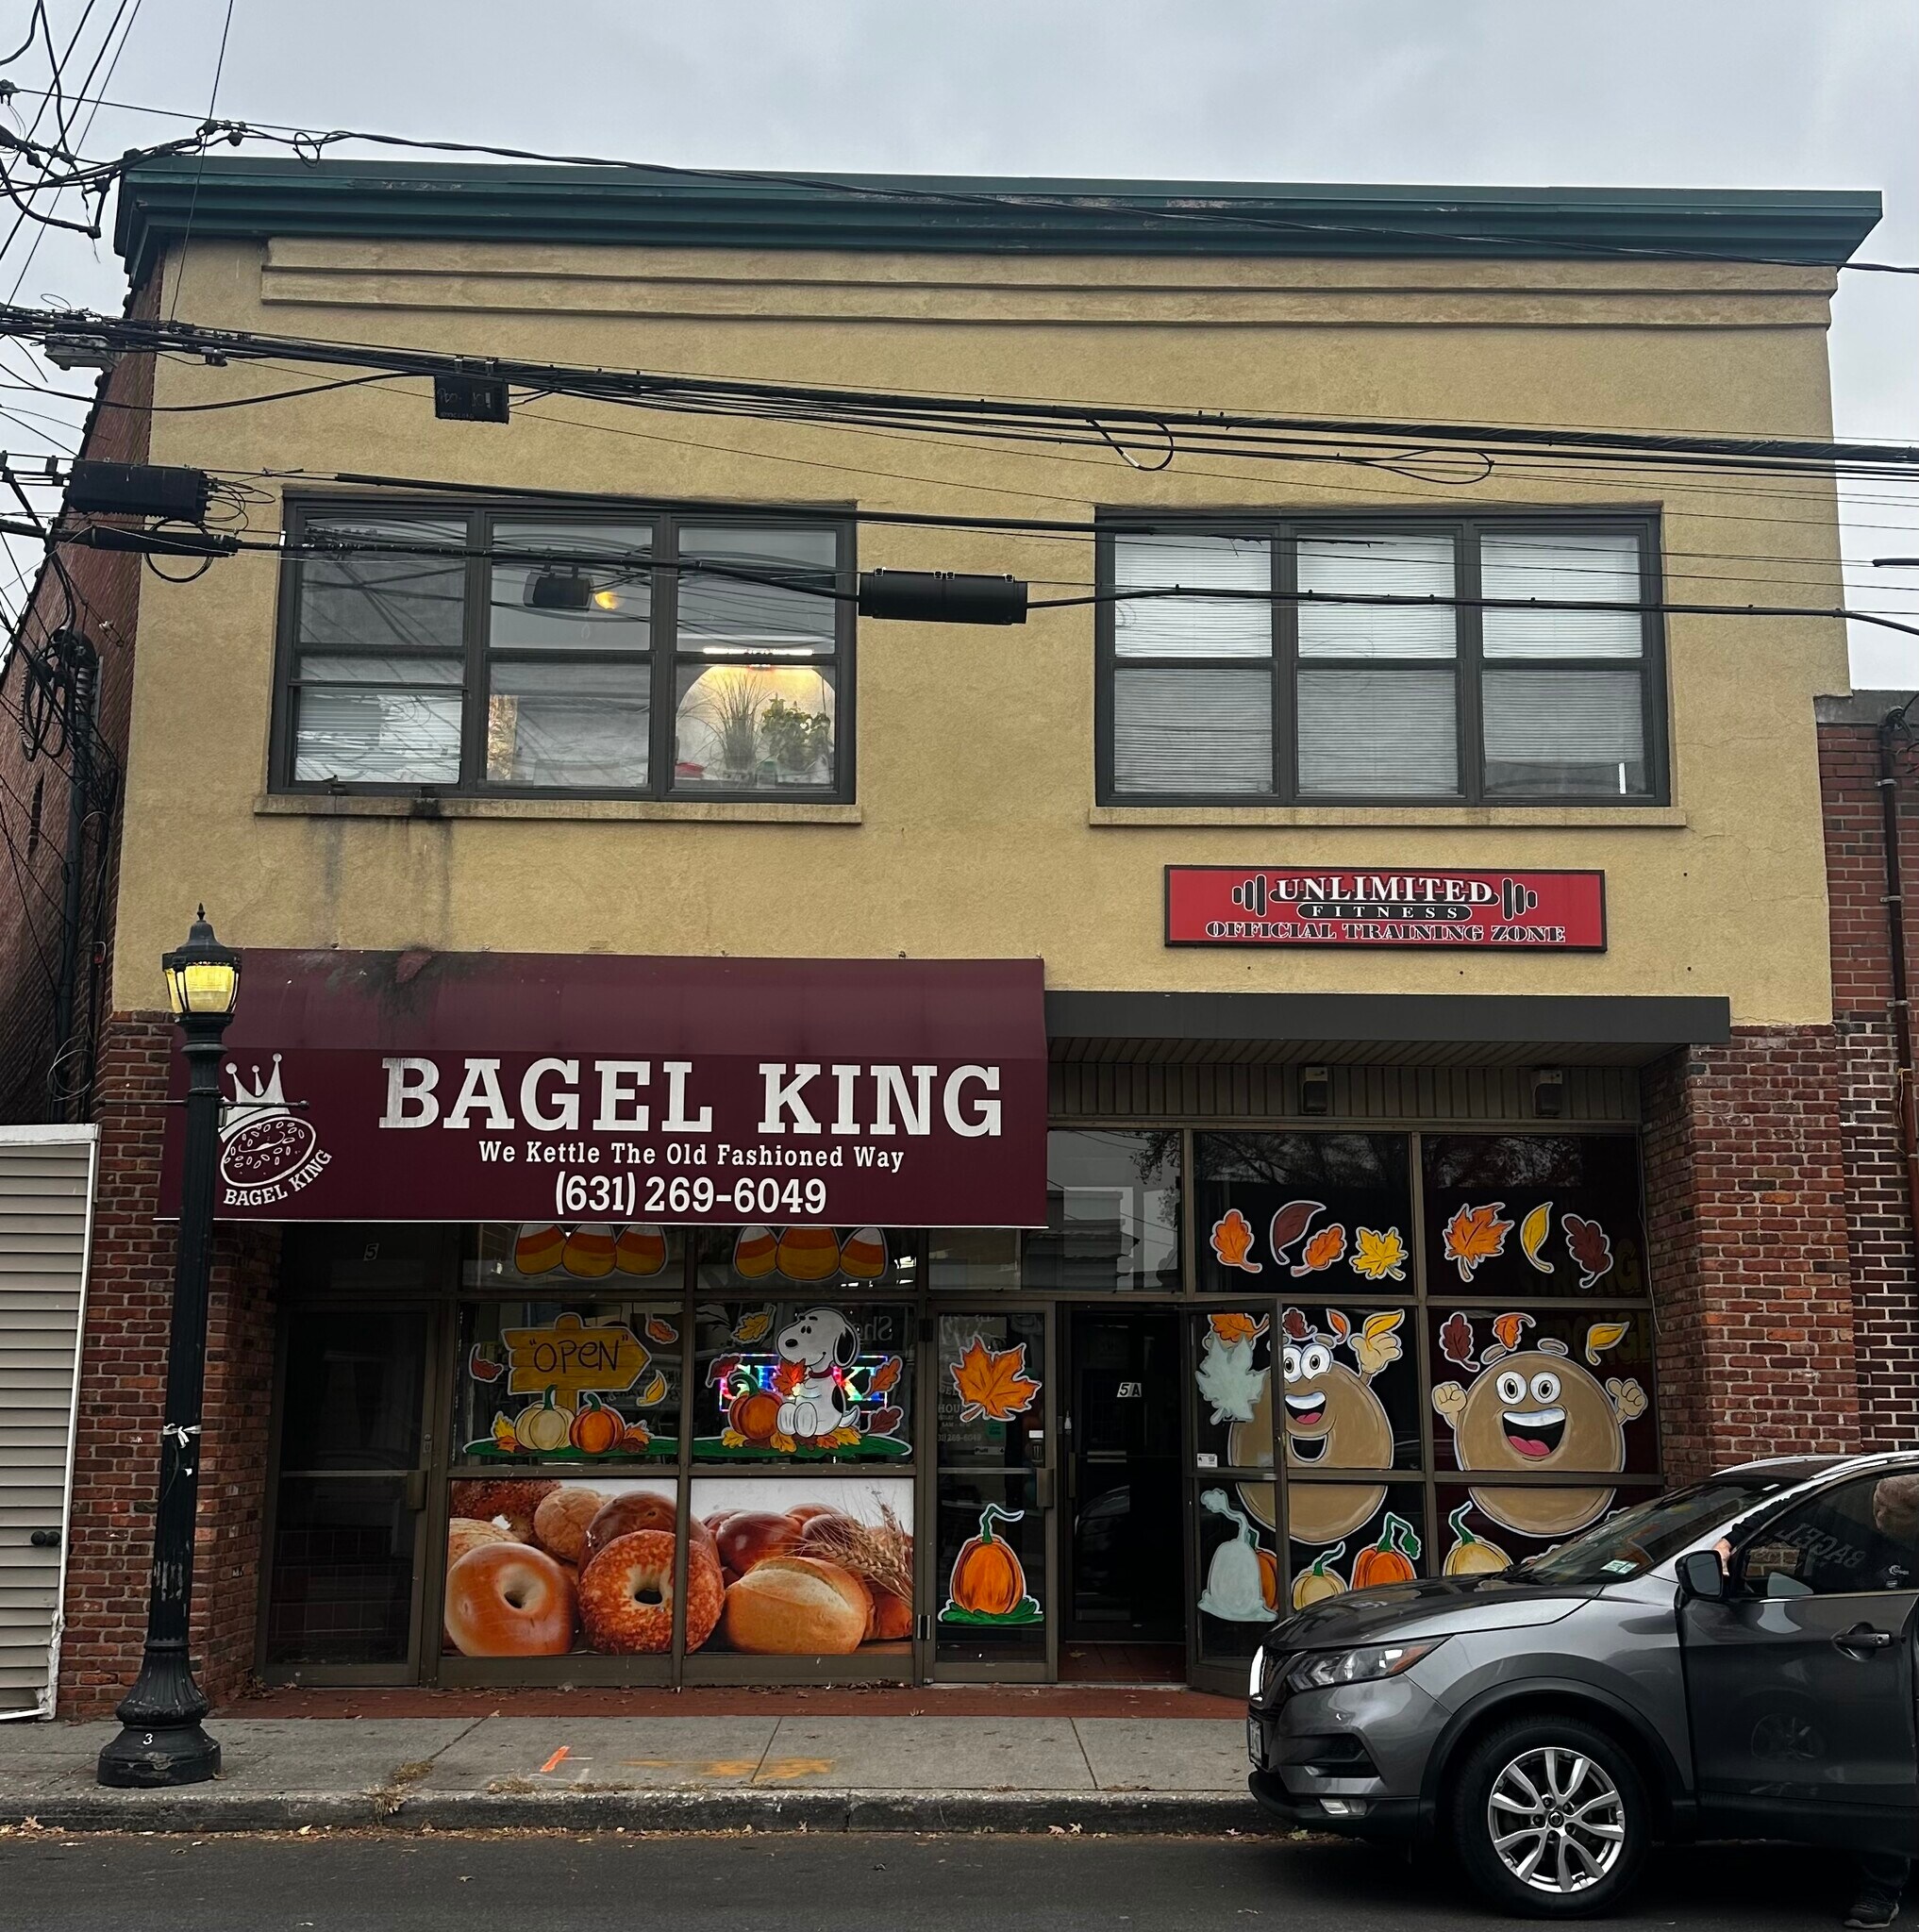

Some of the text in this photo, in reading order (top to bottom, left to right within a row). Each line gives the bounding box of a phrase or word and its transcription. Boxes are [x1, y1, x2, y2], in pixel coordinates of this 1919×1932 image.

[1277, 875, 1493, 903] UNLIMITED
[1311, 905, 1459, 919] FITNESS
[1205, 921, 1566, 942] OFFICIAL TRAINING ZONE
[378, 1058, 1002, 1138] BAGEL KING
[478, 1141, 905, 1173] We Kettle The Old Fashioned Way
[223, 1149, 333, 1207] BAGEL KING
[555, 1171, 826, 1216] (631) 269-6049
[365, 1243, 378, 1260] 5
[1118, 1383, 1141, 1396] 5A
[142, 1733, 154, 1745] 3
